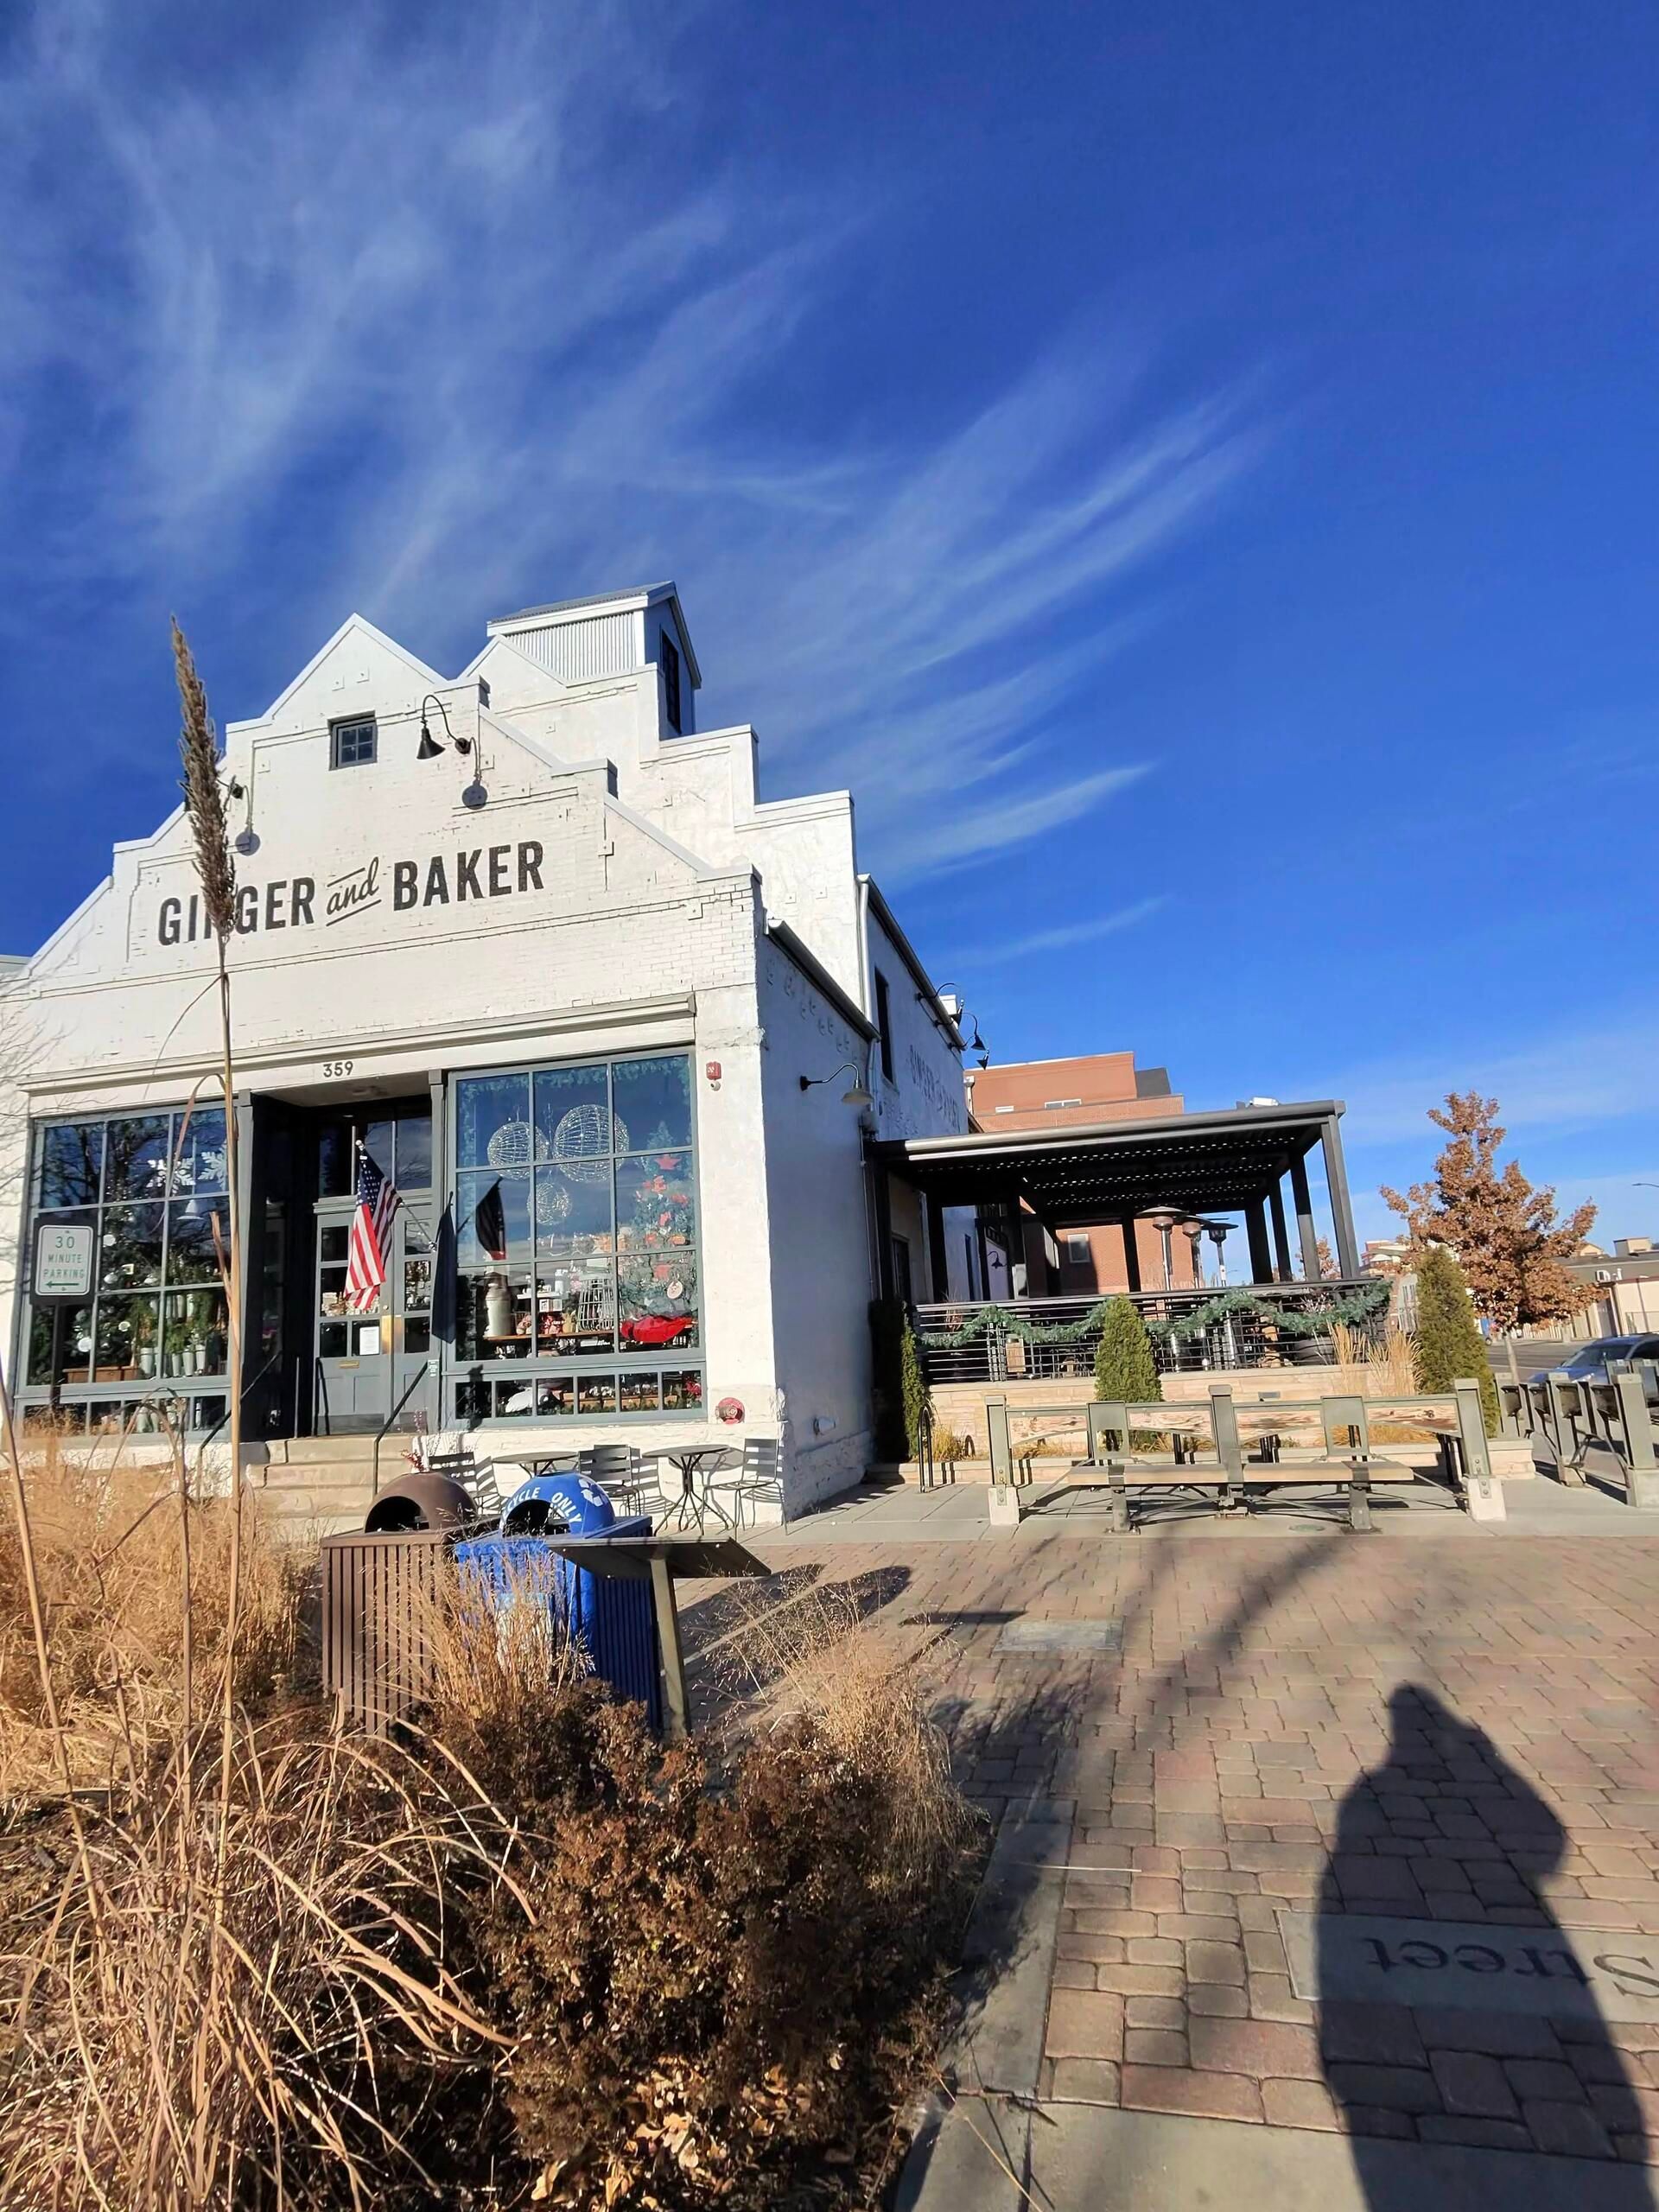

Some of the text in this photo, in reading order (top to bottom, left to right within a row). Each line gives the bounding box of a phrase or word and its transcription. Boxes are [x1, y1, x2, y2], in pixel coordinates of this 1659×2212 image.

[327, 856, 379, 913] and
[393, 840, 544, 912] BAKER
[323, 1060, 353, 1078] 359
[55, 1236, 75, 1249] 30
[48, 1254, 83, 1263] MINUTE
[43, 1268, 85, 1279] PARKING
[500, 1487, 582, 1523] CYCLE ONLY
[1362, 1938, 1659, 1998] Street
